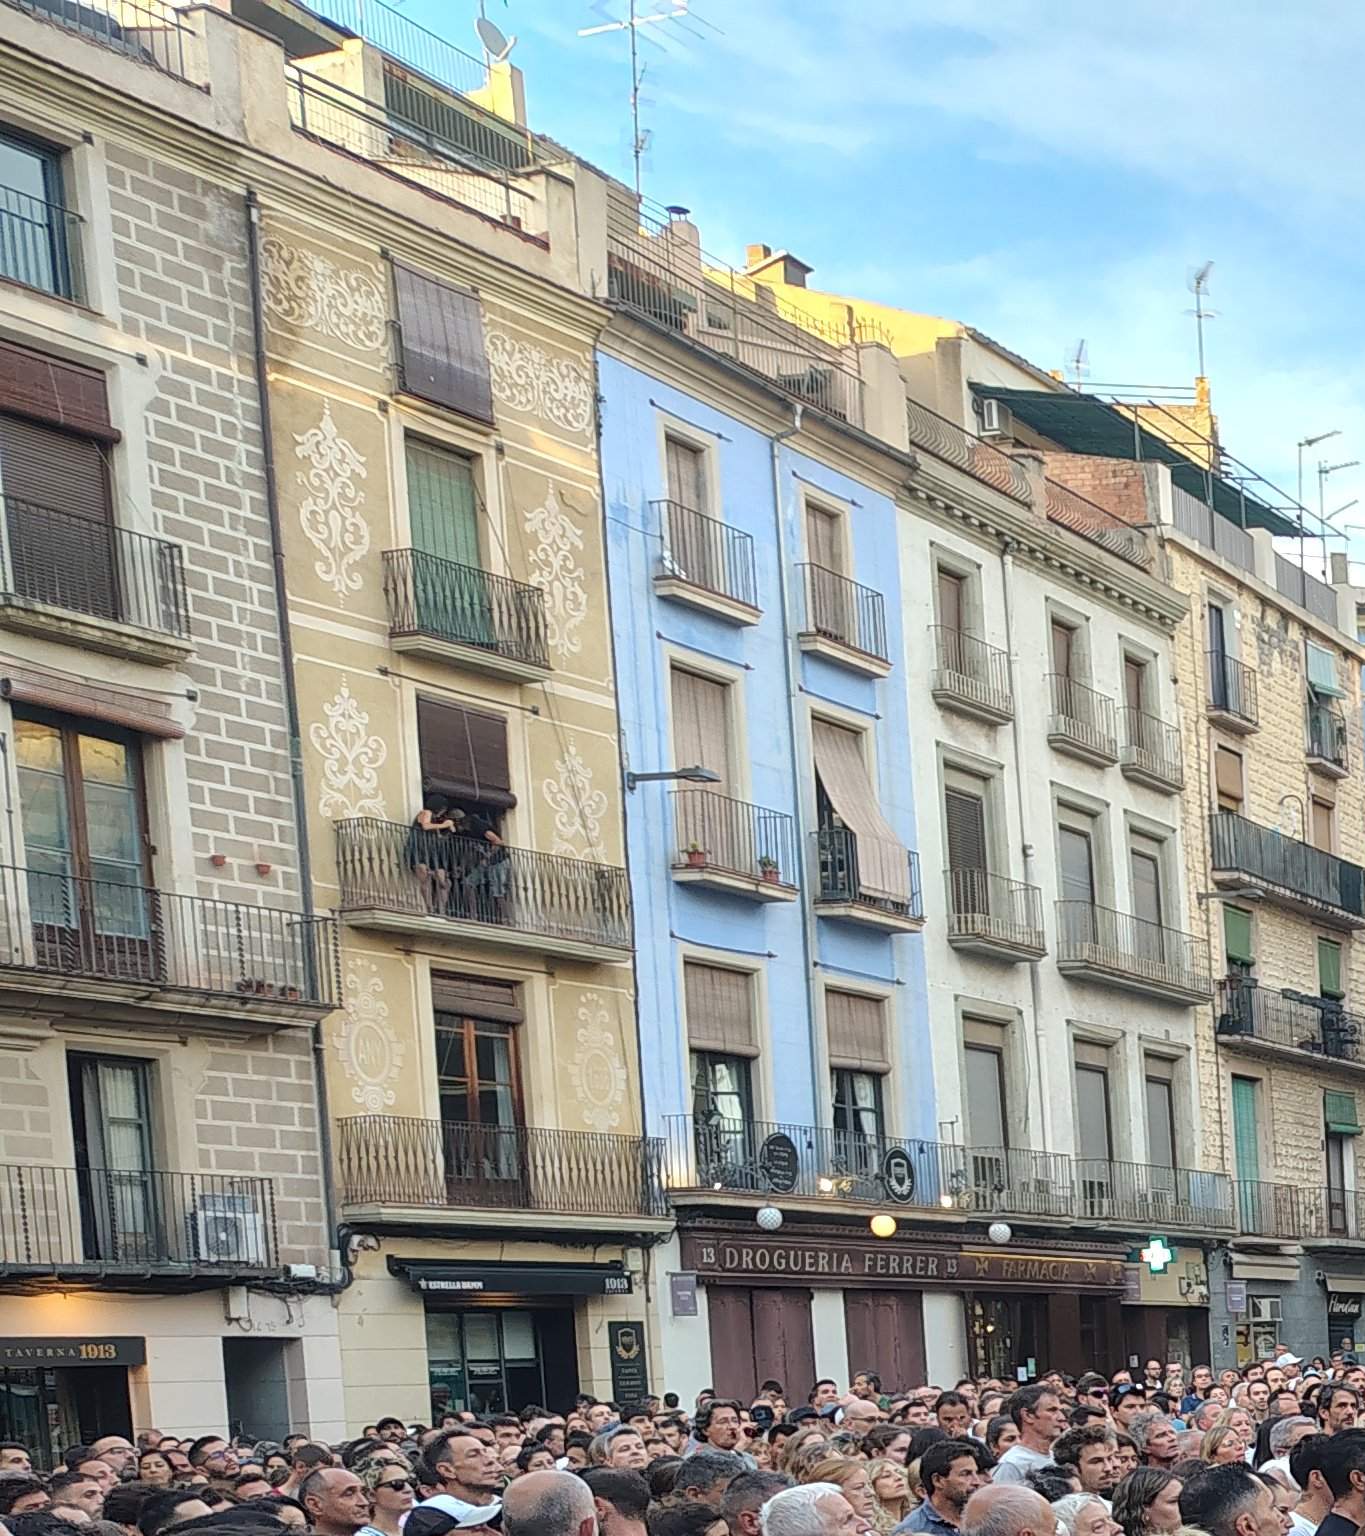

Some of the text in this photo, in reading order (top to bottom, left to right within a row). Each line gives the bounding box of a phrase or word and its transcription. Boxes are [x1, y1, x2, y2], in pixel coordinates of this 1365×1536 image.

[702, 1247, 716, 1264] 13
[724, 1247, 939, 1276] DROGUERIA FERRER
[947, 1258, 958, 1274] 13
[5, 1344, 116, 1359] TAVERNA 1913
